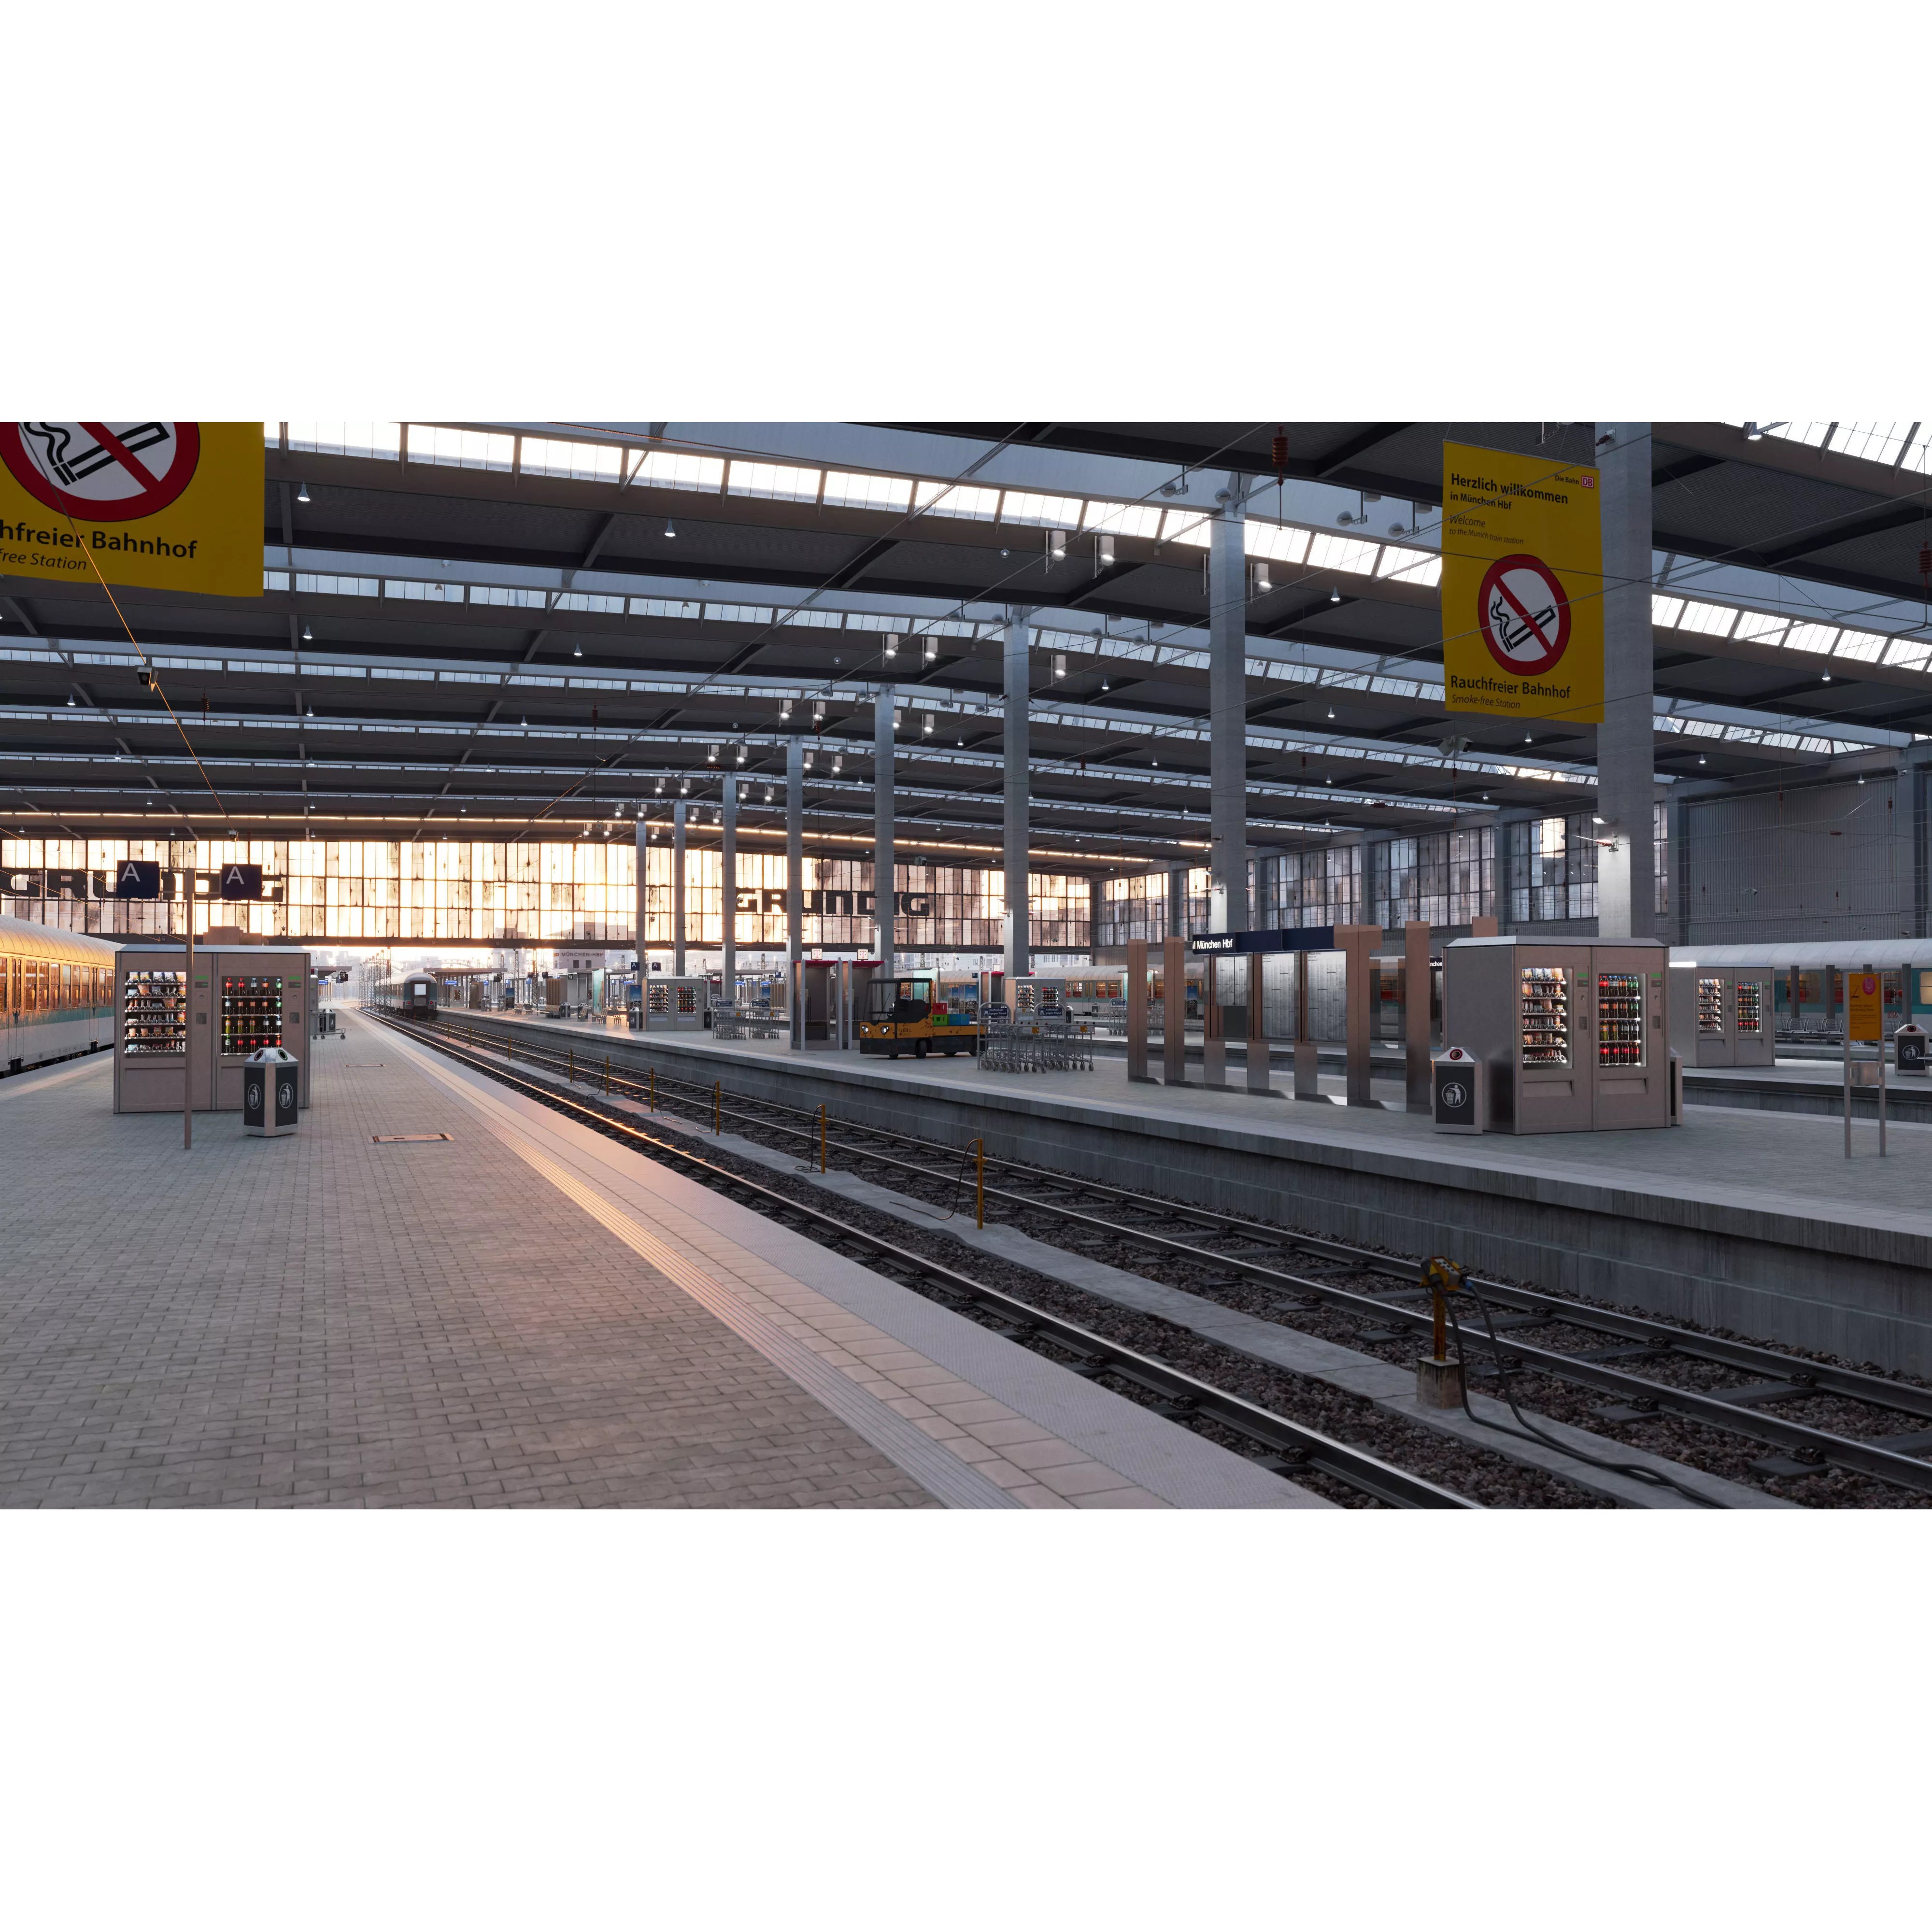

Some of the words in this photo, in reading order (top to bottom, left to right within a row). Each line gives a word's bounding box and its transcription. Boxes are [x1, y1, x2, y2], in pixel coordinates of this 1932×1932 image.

[1451, 473, 1497, 492] Herzlich
[1500, 483, 1568, 504] willkommen
[1565, 476, 1579, 484] Bahn
[1582, 477, 1593, 487] DB
[1450, 492, 1458, 500] in
[1460, 493, 1496, 507] München
[1498, 499, 1512, 510] Hbf
[1449, 515, 1486, 527] Welcome
[1458, 527, 1467, 536] the
[1468, 529, 1489, 539] Munich
[1490, 534, 1502, 542] train
[1504, 536, 1523, 544] station
[92, 530, 198, 559] Bahnhof
[30, 553, 87, 570] Station
[1451, 675, 1519, 694] Rauchfreier
[1522, 682, 1571, 699] Bahnhof
[1452, 694, 1493, 706] Smoke-free
[1496, 698, 1520, 709] Station
[121, 863, 141, 882] A
[226, 866, 245, 885] A
[1197, 939, 1221, 950] München
[1222, 938, 1233, 948] Hbf
